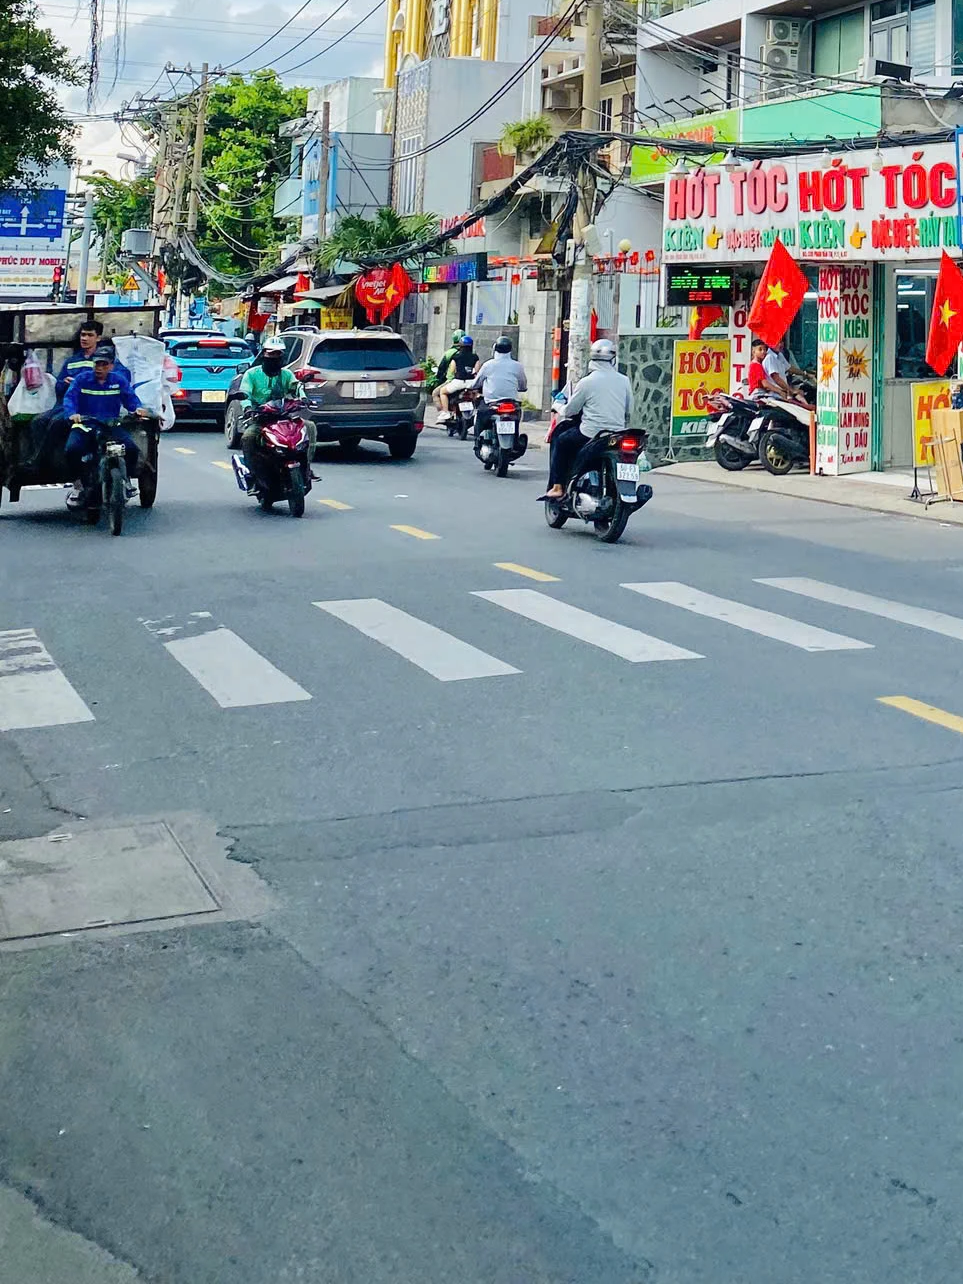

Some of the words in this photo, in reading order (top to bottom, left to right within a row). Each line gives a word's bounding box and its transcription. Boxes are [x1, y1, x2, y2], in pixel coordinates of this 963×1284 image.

[669, 167, 720, 220] HỚT
[729, 160, 788, 216] TÓC
[798, 158, 869, 213] HỚT
[880, 151, 957, 209] TÓC
[664, 221, 704, 252] KIÊN
[799, 212, 846, 249] KIÊN
[20, 257, 37, 266] DUY
[39, 257, 67, 266] MOBILE
[820, 264, 840, 290] HỚT
[818, 292, 839, 319] TÓC
[842, 289, 869, 316] TÓC
[844, 316, 869, 338] KIÊN
[678, 345, 728, 374] HỚT
[841, 389, 853, 408] RÁY
[856, 391, 866, 408] TAI
